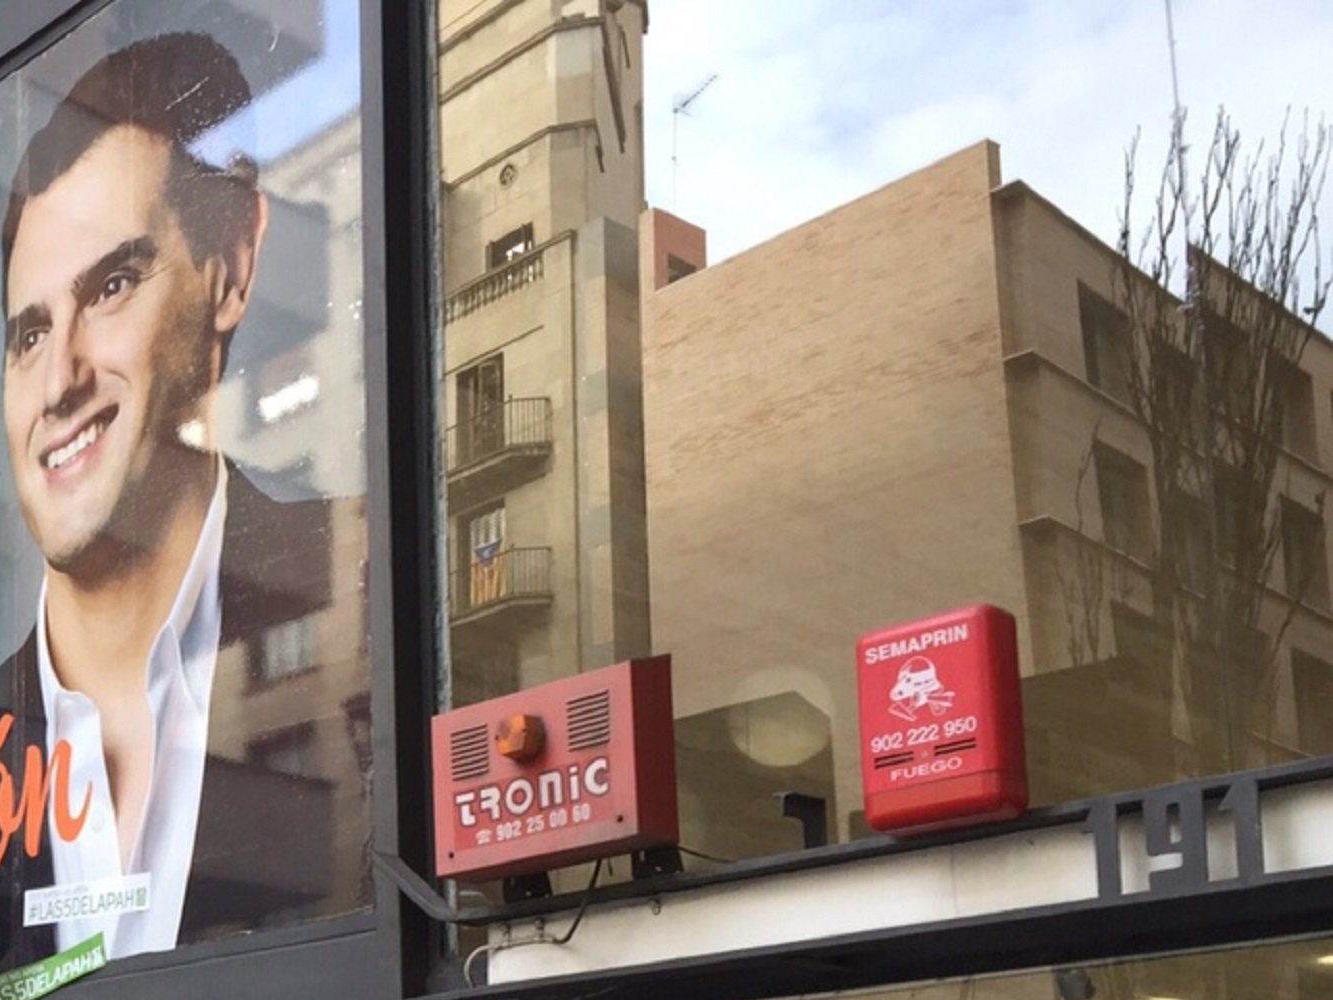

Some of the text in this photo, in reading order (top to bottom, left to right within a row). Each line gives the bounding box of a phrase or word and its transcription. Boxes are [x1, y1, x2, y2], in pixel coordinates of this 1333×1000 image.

[865, 624, 969, 664] SEMAPRIN
[871, 716, 977, 752] 902 222 950
[890, 756, 963, 781] FUEGO
[526, 815, 544, 834] 25
[1082, 777, 1265, 897] 191
[29, 889, 134, 921] #LAS5DELAPAH
